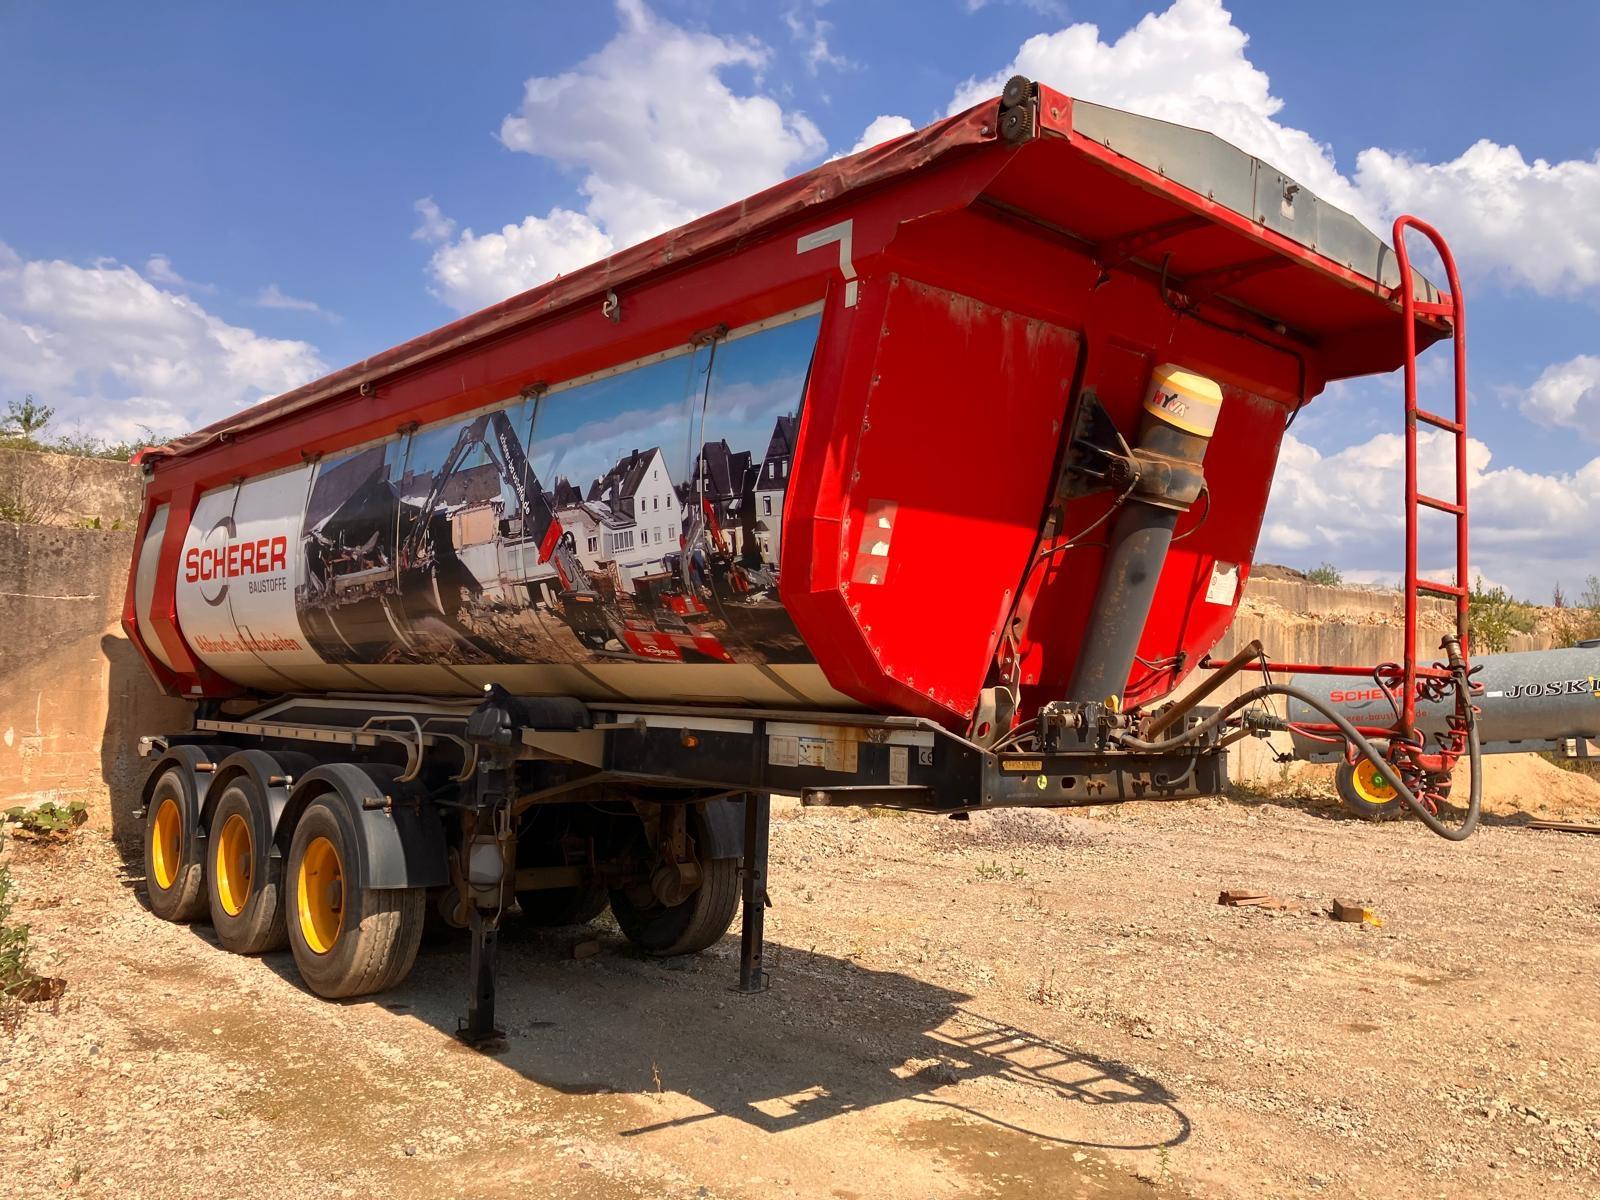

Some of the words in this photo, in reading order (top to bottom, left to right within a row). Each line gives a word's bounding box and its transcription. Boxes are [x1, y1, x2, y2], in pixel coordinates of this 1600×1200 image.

[1152, 390, 1185, 417] HYVA
[185, 535, 287, 584] SCHERER
[248, 577, 287, 594] BAUSTOFFE
